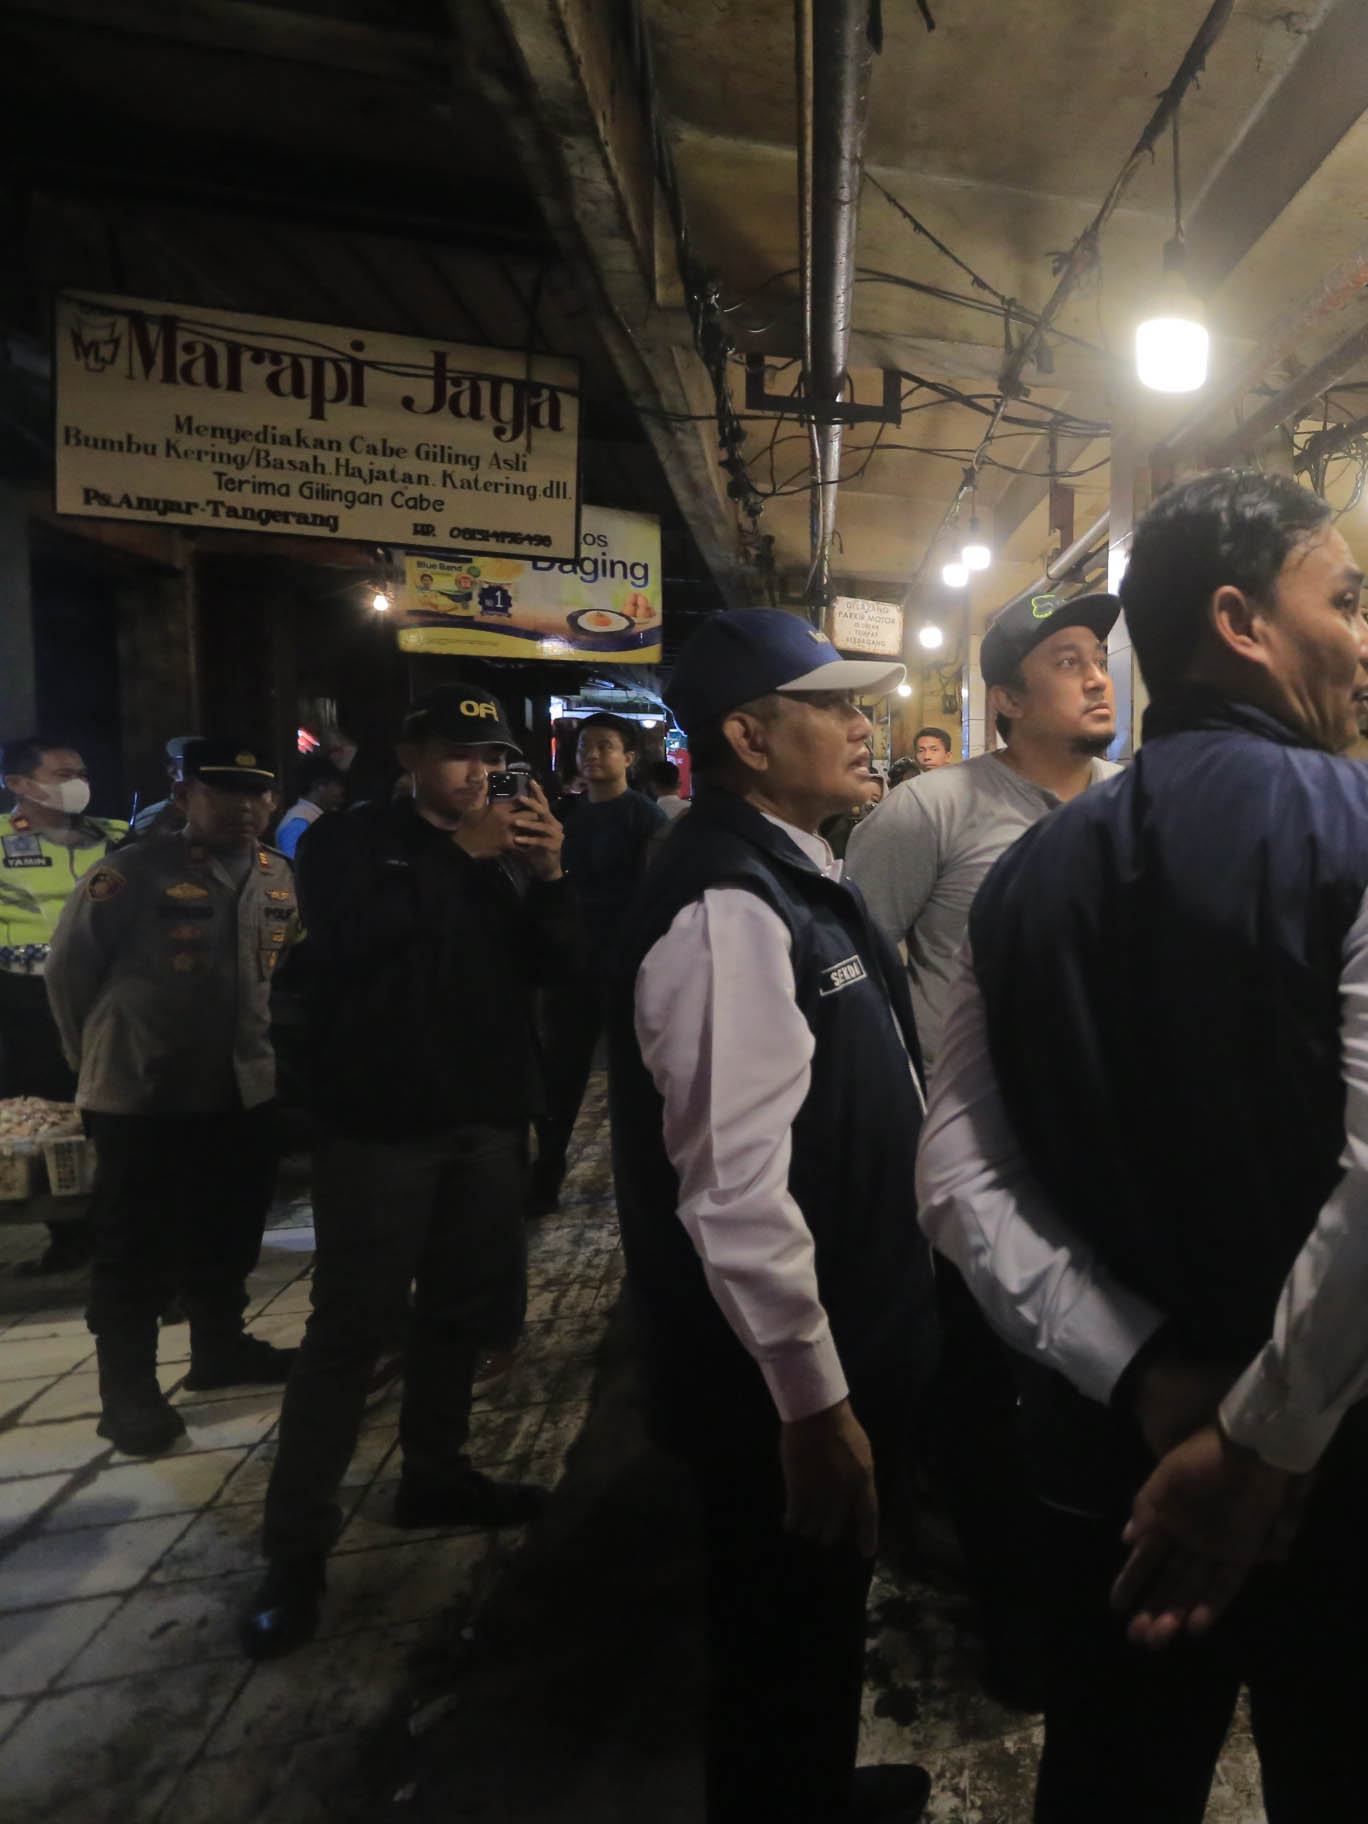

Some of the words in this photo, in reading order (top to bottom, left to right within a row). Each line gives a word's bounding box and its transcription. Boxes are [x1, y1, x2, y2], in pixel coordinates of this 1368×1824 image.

[126, 313, 368, 422] Marapi
[401, 350, 564, 443] Jaya
[63, 425, 157, 457] Bumbu
[175, 413, 342, 452] Menyediakan
[350, 435, 408, 459] Cabe
[415, 442, 481, 472] Giling
[489, 451, 528, 473] Asli
[213, 471, 290, 497] Terima
[300, 481, 383, 509] Gilingan
[391, 490, 445, 512] Cabe
[581, 533, 608, 547] os
